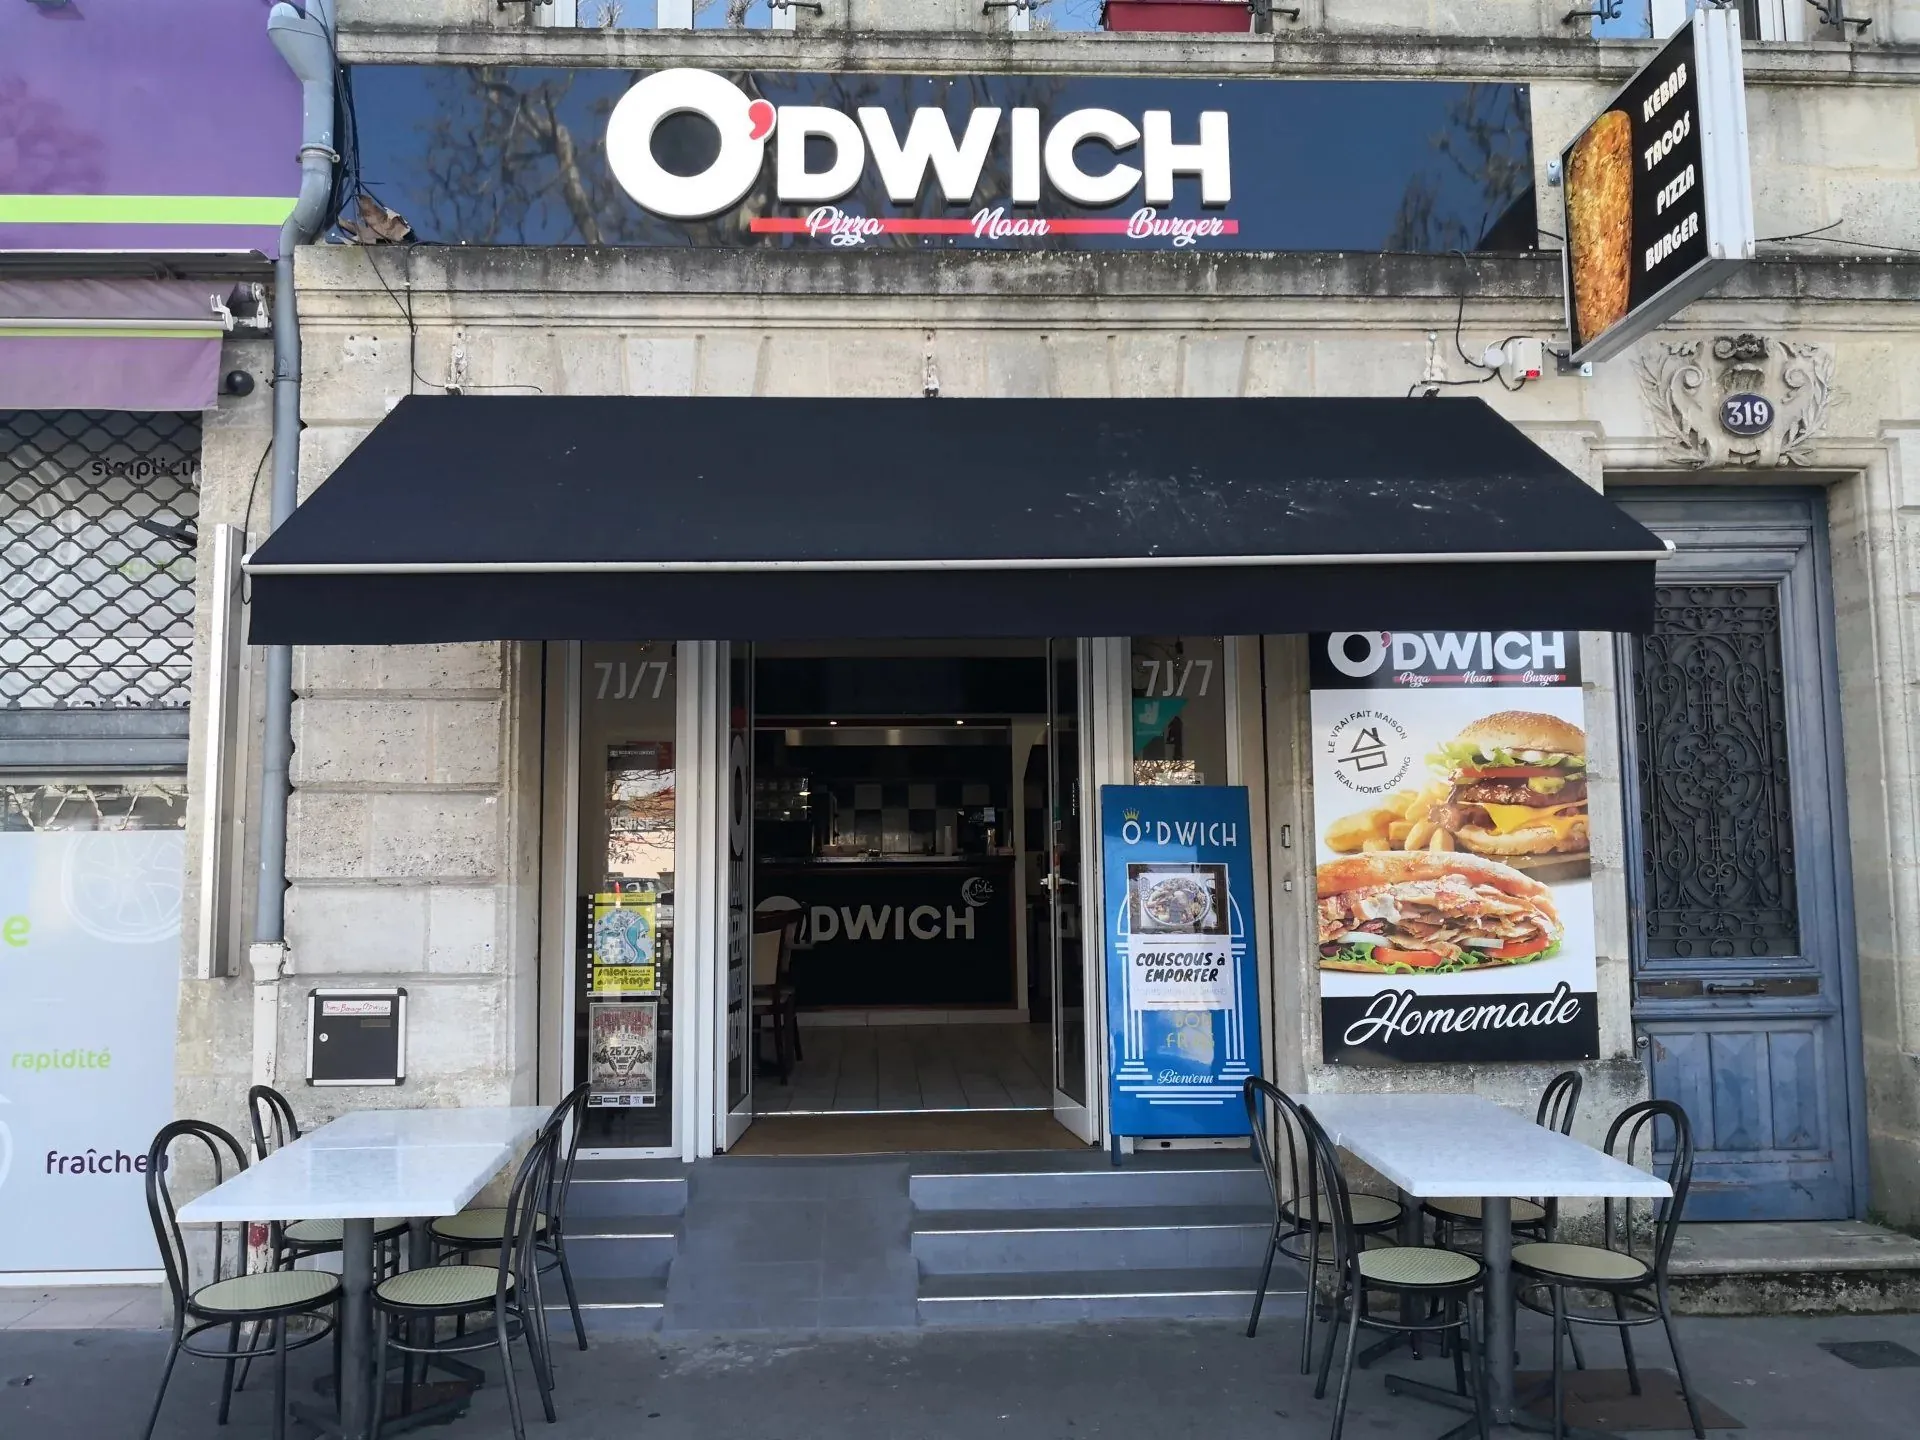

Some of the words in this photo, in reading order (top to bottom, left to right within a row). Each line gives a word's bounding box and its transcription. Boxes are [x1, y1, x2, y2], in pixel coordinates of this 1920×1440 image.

[1643, 62, 1687, 122] KEBAB
[606, 67, 1231, 218] O'DWICH
[1644, 111, 1691, 171] TACOS
[1657, 164, 1695, 215] PIZZA
[805, 206, 884, 245] Pizza
[971, 206, 1050, 238] Naan
[1128, 206, 1223, 245] Burger
[1645, 212, 1698, 271] BURGER
[1728, 402, 1769, 426] 319
[1327, 631, 1566, 677] O'DWICH
[594, 661, 668, 699] 7J/7
[1142, 660, 1212, 696] 7J/7
[1400, 672, 1430, 687] Pizza
[1463, 671, 1493, 683] Naan
[1522, 671, 1559, 686] Burger
[1330, 717, 1350, 737] VRAI
[1350, 710, 1372, 720] FAIT
[1374, 711, 1407, 740] MAISON
[1328, 741, 1336, 753] LE
[1334, 769, 1354, 789] REAL
[1355, 784, 1383, 794] HOME
[1384, 756, 1411, 790] COOKING
[1122, 820, 1237, 847] O'DWICH
[1136, 953, 1214, 967] COUSCOUS
[1217, 954, 1226, 966] à
[1145, 969, 1219, 983] EMPORTER
[1343, 986, 1581, 1044] Homemade
[11, 1046, 112, 1073] rapidité
[1157, 1069, 1214, 1084] Bienvenu
